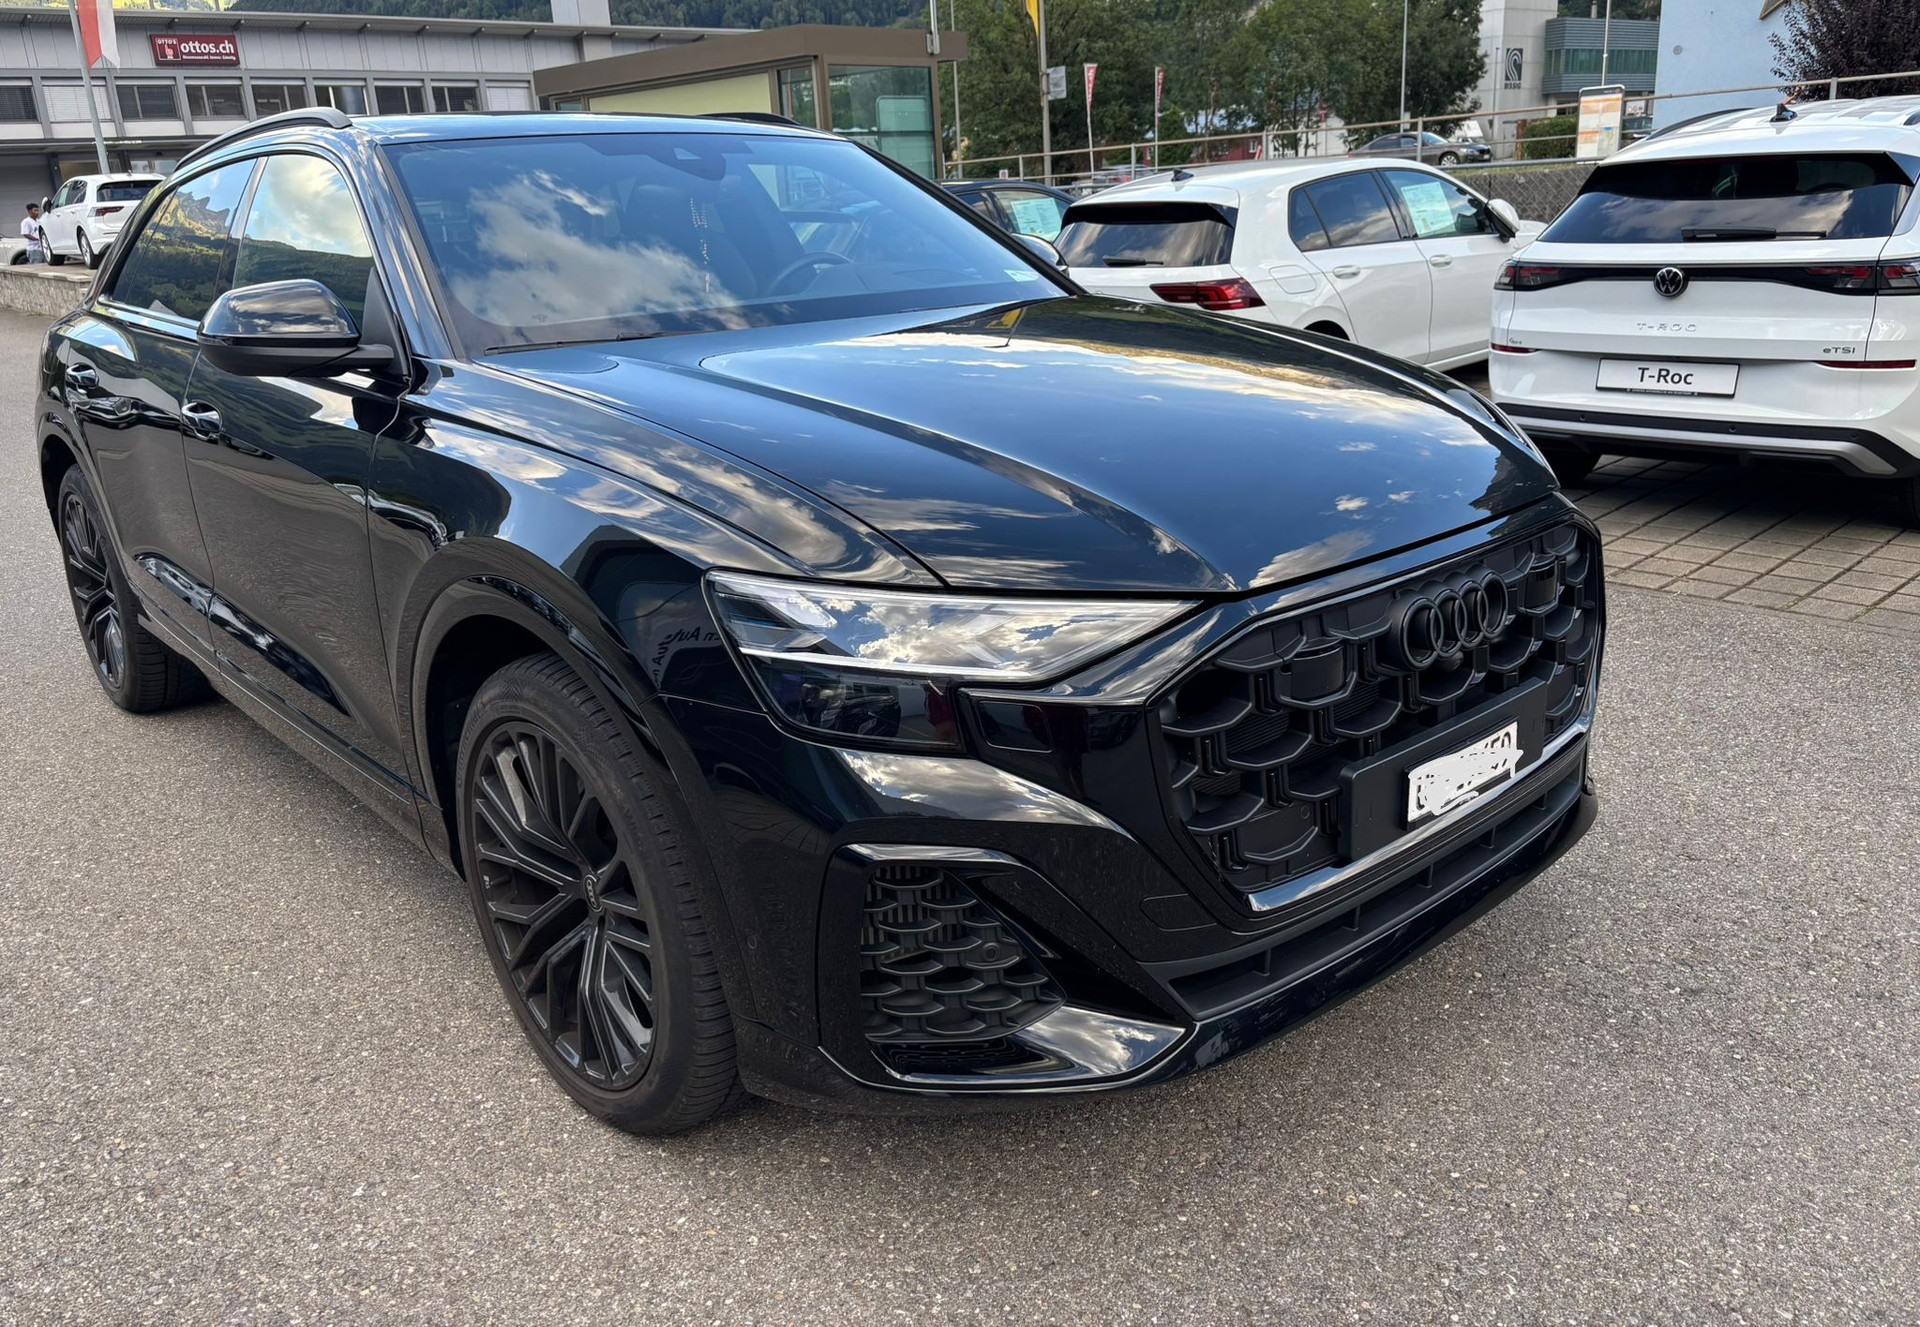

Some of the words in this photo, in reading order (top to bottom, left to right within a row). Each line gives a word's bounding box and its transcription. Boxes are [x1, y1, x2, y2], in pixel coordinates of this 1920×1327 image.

[180, 39, 235, 54] ottos.ch
[1636, 322, 1697, 333] T-ROC
[1822, 346, 1856, 355] eTSI
[1637, 366, 1694, 386] T-Roc
